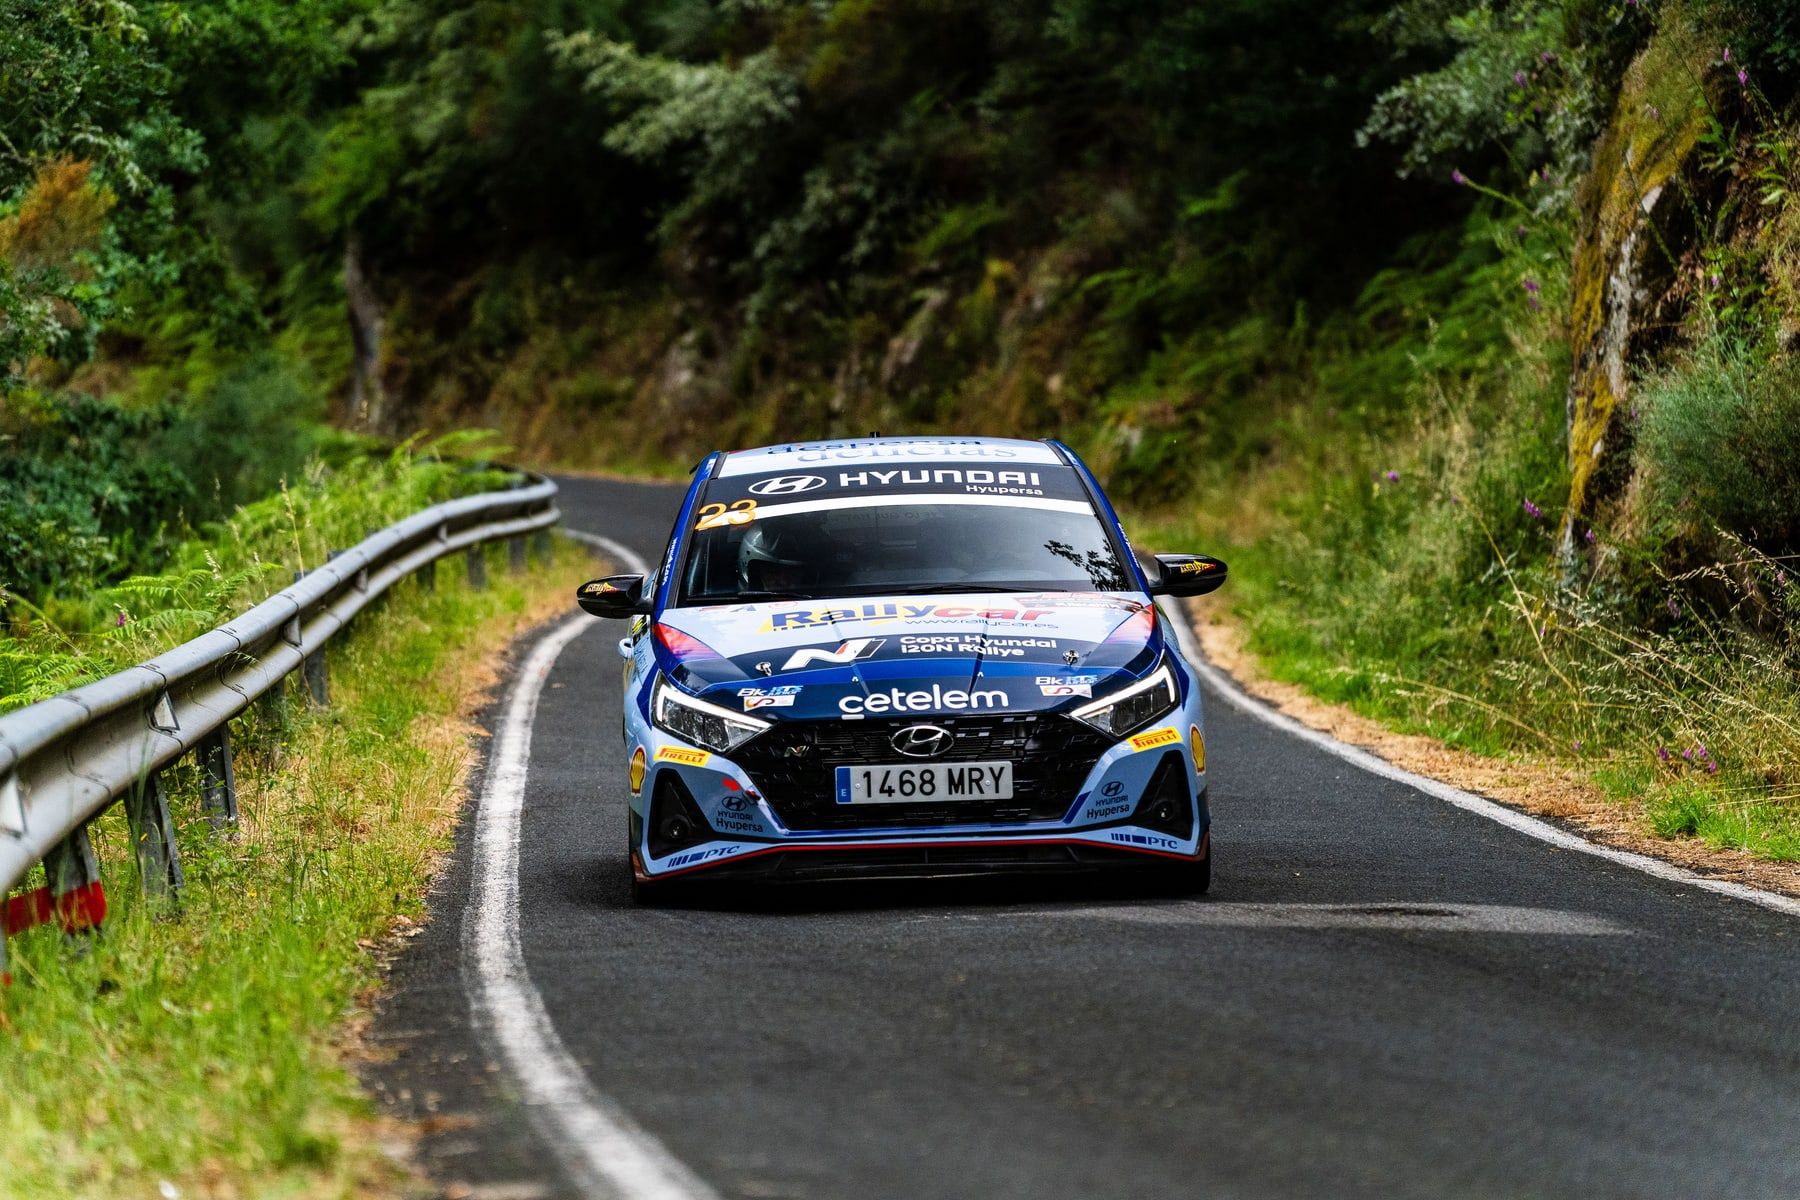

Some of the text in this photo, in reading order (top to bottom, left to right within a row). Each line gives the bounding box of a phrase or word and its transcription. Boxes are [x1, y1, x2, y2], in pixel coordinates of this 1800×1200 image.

[839, 470, 1040, 487] HYUNDAI
[966, 485, 1043, 496] Hyupersa
[695, 499, 758, 531] 23
[900, 635, 1057, 648] Copa Hyundai
[958, 643, 1025, 657] Rallye
[838, 684, 1009, 715] cetelem
[1133, 730, 1177, 748] PIRELLI
[659, 748, 706, 763] PIRELLI
[863, 767, 1005, 798] 1468 MRY
[840, 788, 847, 797] E
[1095, 795, 1129, 807] HYUNDAI
[717, 810, 753, 820] HYUNDAI
[1087, 804, 1130, 819] Hyupersa
[716, 818, 764, 833] Hyupersa
[1148, 836, 1178, 849] PTC
[704, 845, 740, 859] PTC
